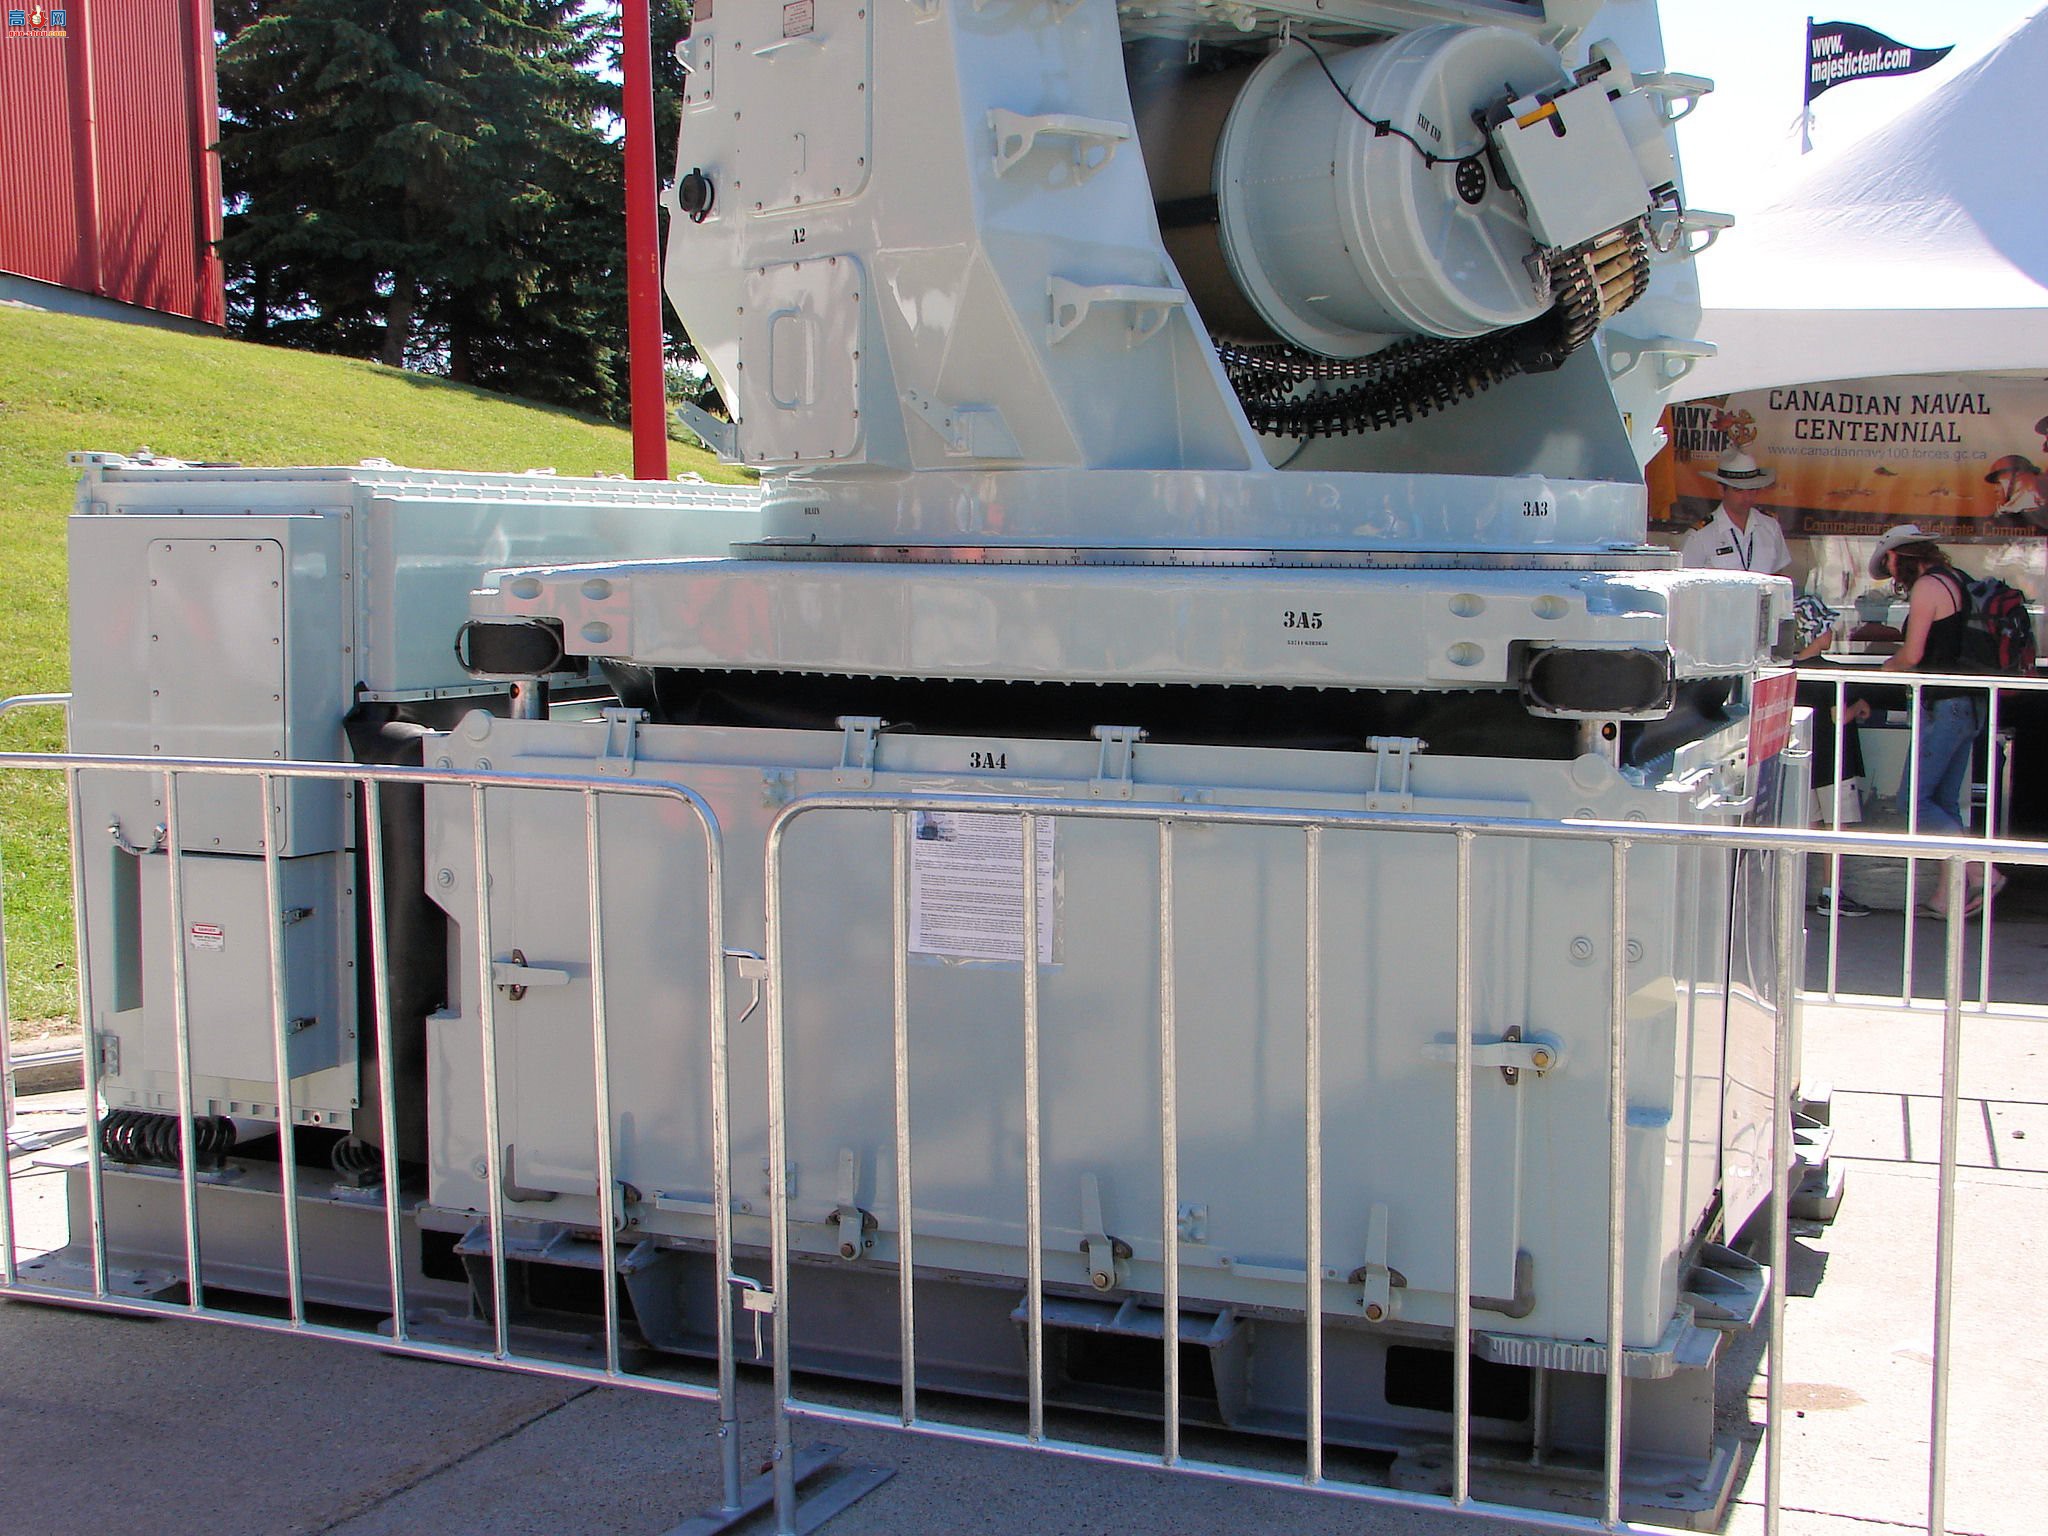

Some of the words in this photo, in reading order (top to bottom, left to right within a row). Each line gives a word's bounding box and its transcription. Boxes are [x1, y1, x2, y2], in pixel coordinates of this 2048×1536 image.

[1812, 34, 1843, 58] www.
[1811, 46, 1911, 86] majestictent.com
[792, 227, 806, 244] A2
[1769, 390, 1901, 415] CANADIAN
[1911, 393, 1990, 414] NAVAL
[1674, 429, 1730, 451] ARINE
[1795, 418, 1961, 443] CENTENNIAL
[1523, 501, 1548, 516] 3A3
[1804, 516, 1897, 534] Commemorat
[1283, 611, 1323, 629] 3A5
[970, 751, 1007, 769] 3A4
